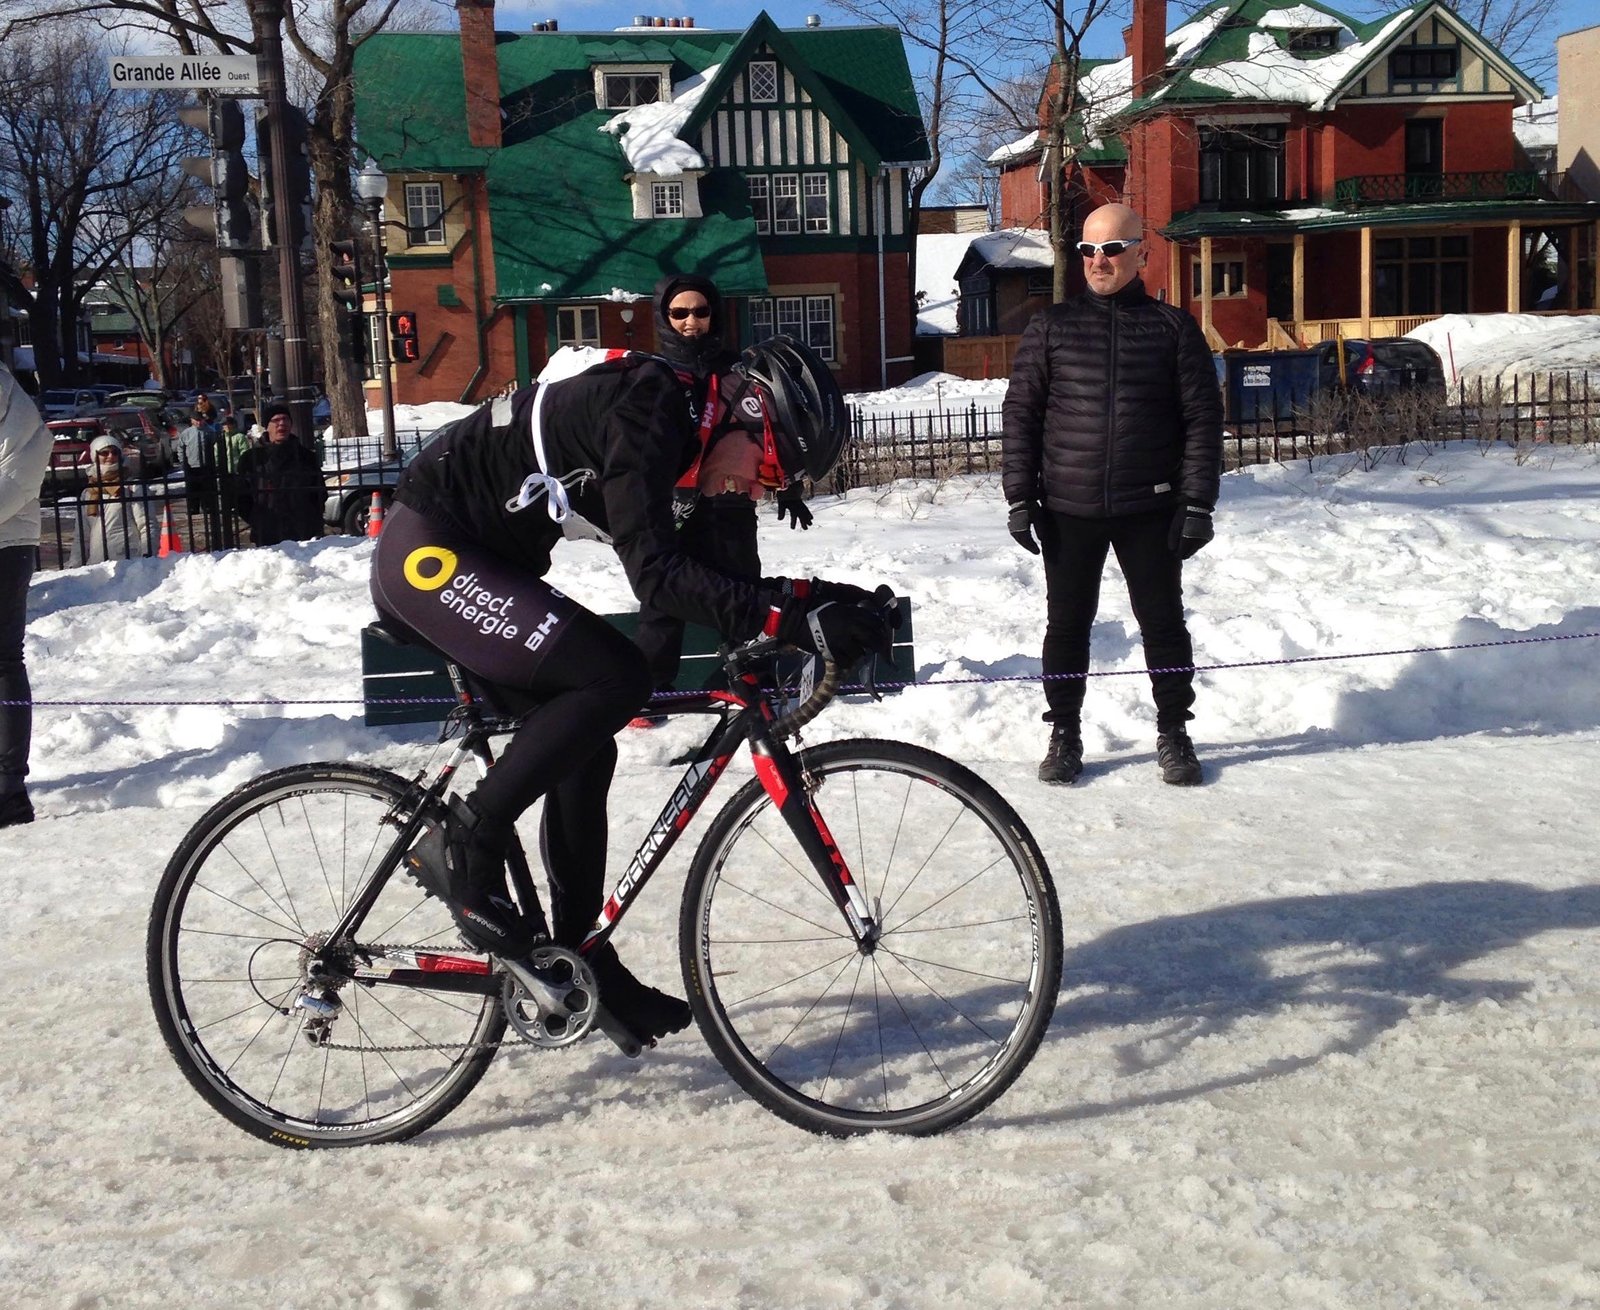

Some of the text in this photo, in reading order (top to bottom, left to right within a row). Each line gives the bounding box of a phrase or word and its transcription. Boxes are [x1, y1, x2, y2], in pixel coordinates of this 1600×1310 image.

[113, 61, 250, 81] Grande Allée Ouest
[439, 589, 518, 639] energie
[453, 573, 514, 616] direct
[524, 612, 559, 652] BH
[615, 763, 704, 902] GARNEAU
[467, 911, 506, 937] GARNEAU
